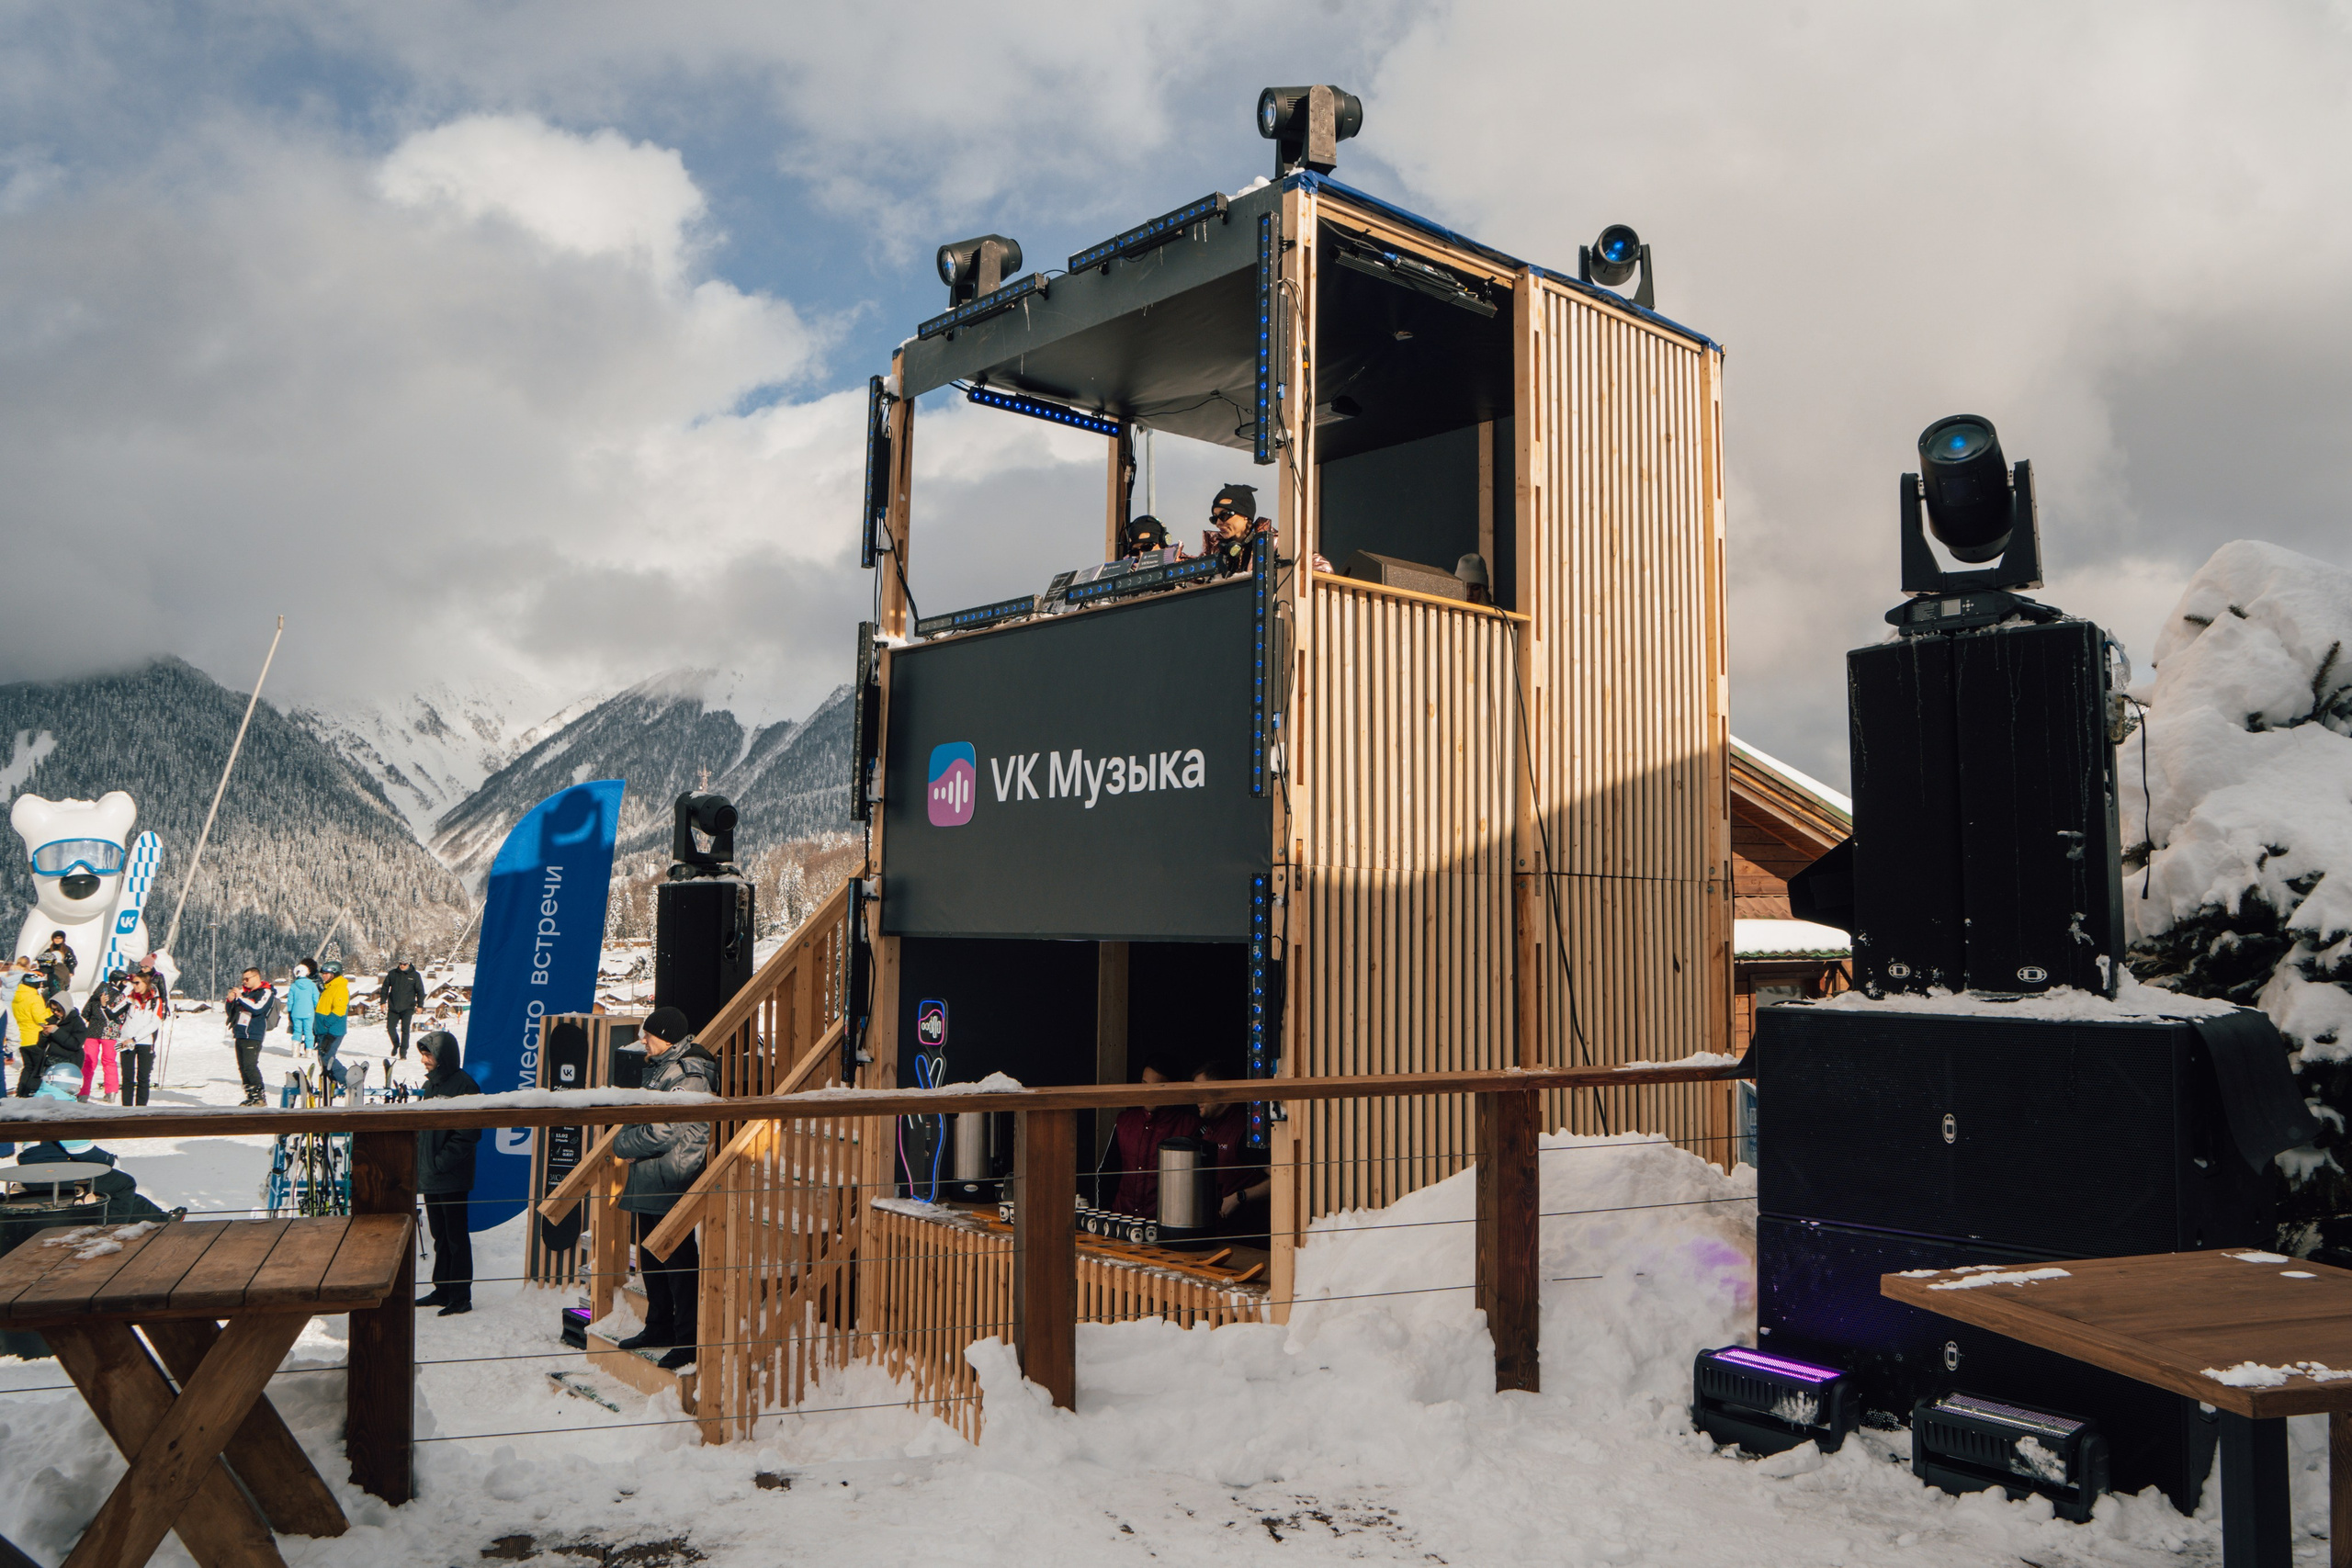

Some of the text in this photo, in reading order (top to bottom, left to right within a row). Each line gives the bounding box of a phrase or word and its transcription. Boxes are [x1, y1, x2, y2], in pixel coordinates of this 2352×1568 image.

[990, 749, 1205, 809] VK Музыка
[120, 917, 136, 928] VK
[530, 865, 563, 986] встречи
